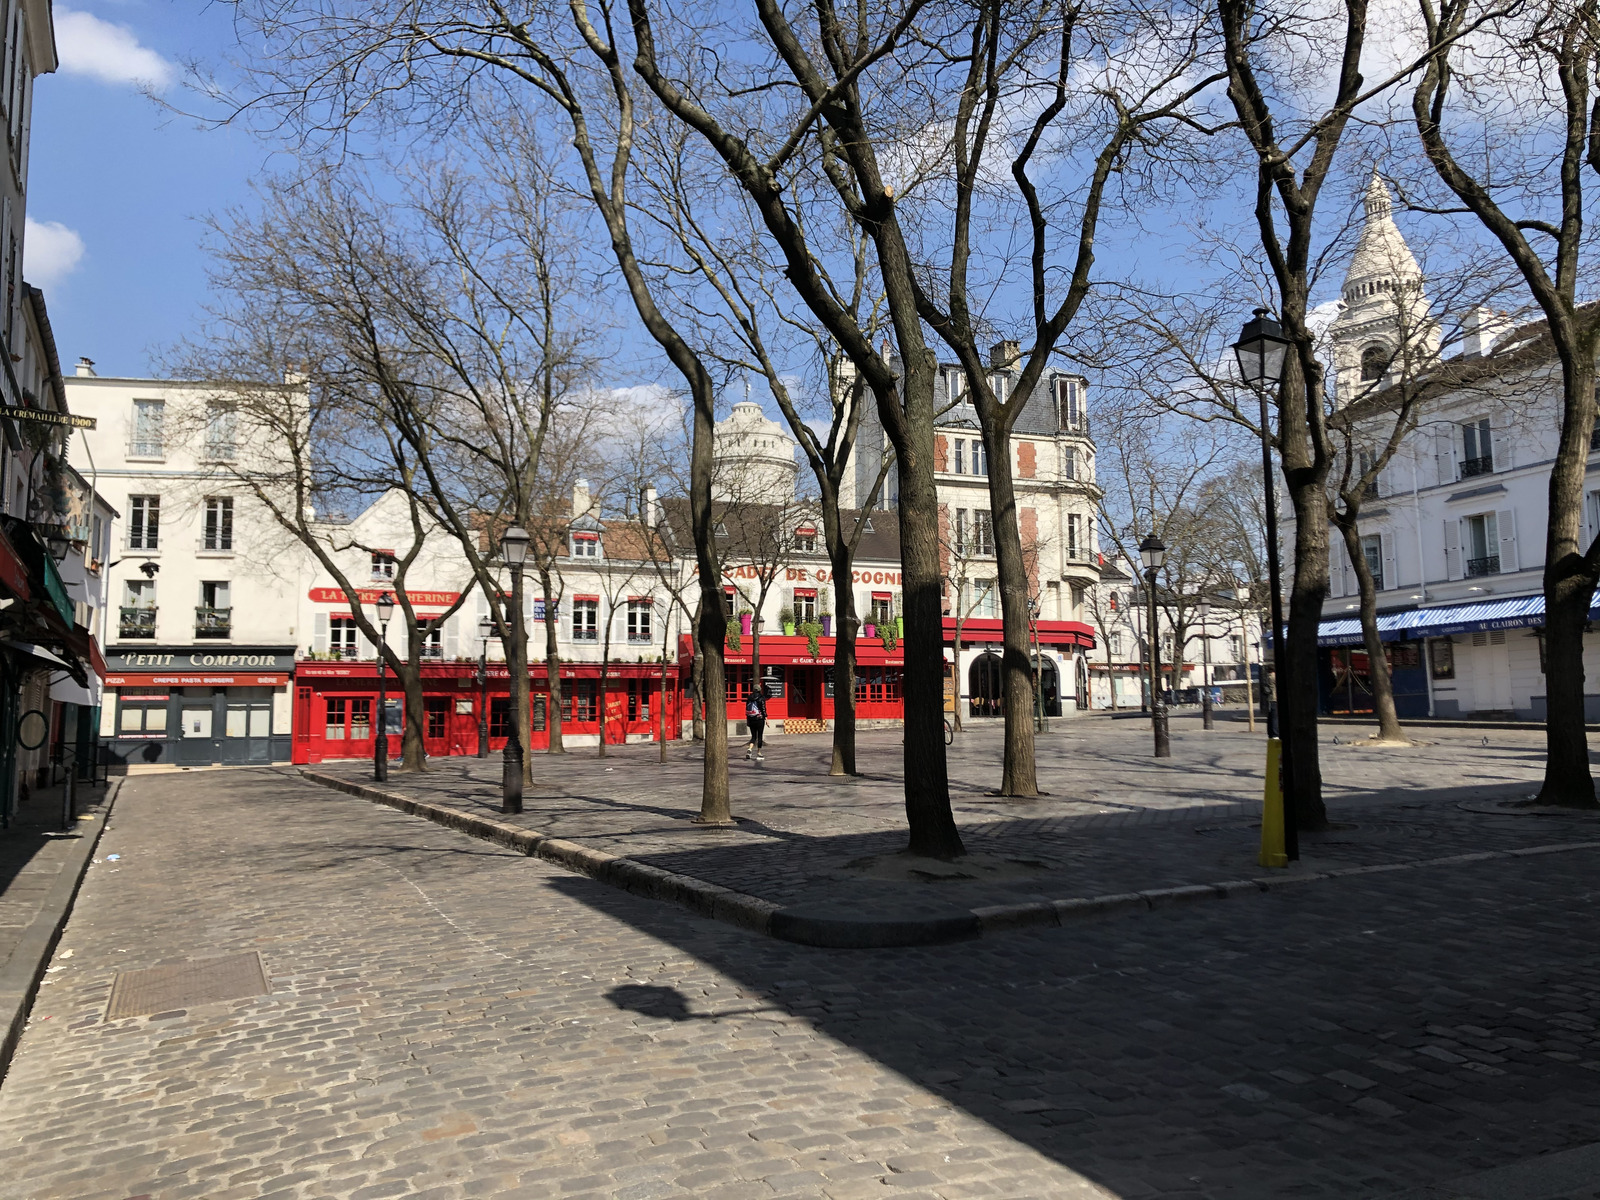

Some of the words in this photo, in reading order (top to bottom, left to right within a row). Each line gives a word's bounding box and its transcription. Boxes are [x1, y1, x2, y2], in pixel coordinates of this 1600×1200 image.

[723, 564, 777, 580] CADET
[786, 567, 808, 581] DE
[816, 568, 903, 586] GACOGN
[320, 590, 337, 600] LA
[340, 591, 378, 601] MRE
[383, 592, 454, 603] AHERINE
[1479, 622, 1488, 630] AU
[1491, 618, 1524, 629] CLAIRON
[1527, 617, 1542, 625] DES
[120, 652, 175, 666] PETIT
[189, 652, 276, 666] COMPTOIR
